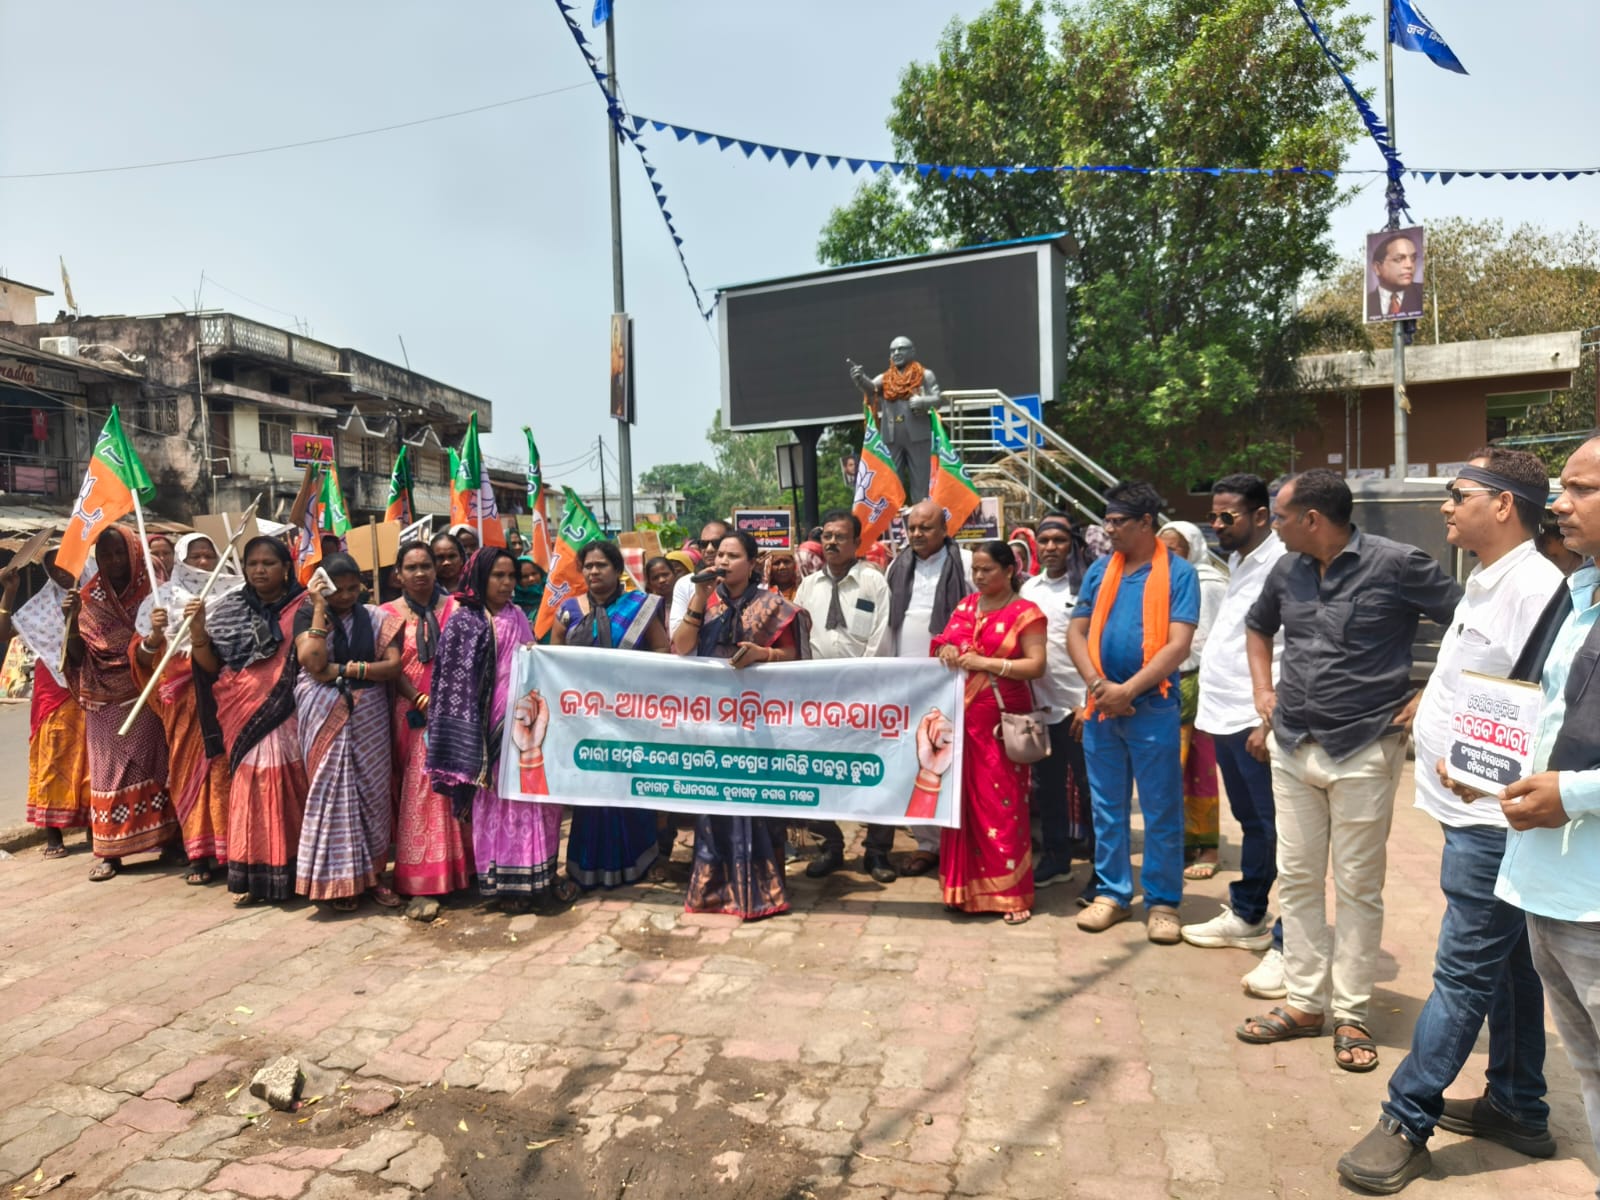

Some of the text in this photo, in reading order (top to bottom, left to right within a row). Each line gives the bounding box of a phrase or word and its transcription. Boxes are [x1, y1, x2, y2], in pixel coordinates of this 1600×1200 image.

[560, 690, 910, 738] ଜନ-ଆକ୍ରୋଶ ମହିଳା ପଦଯାତ୍ରା
[1494, 723, 1530, 753] ନାରୀ
[579, 746, 609, 763] ନାରୀ
[721, 753, 768, 774] କଂଗ୍ରେସ
[771, 754, 809, 776] ମାରିଛି
